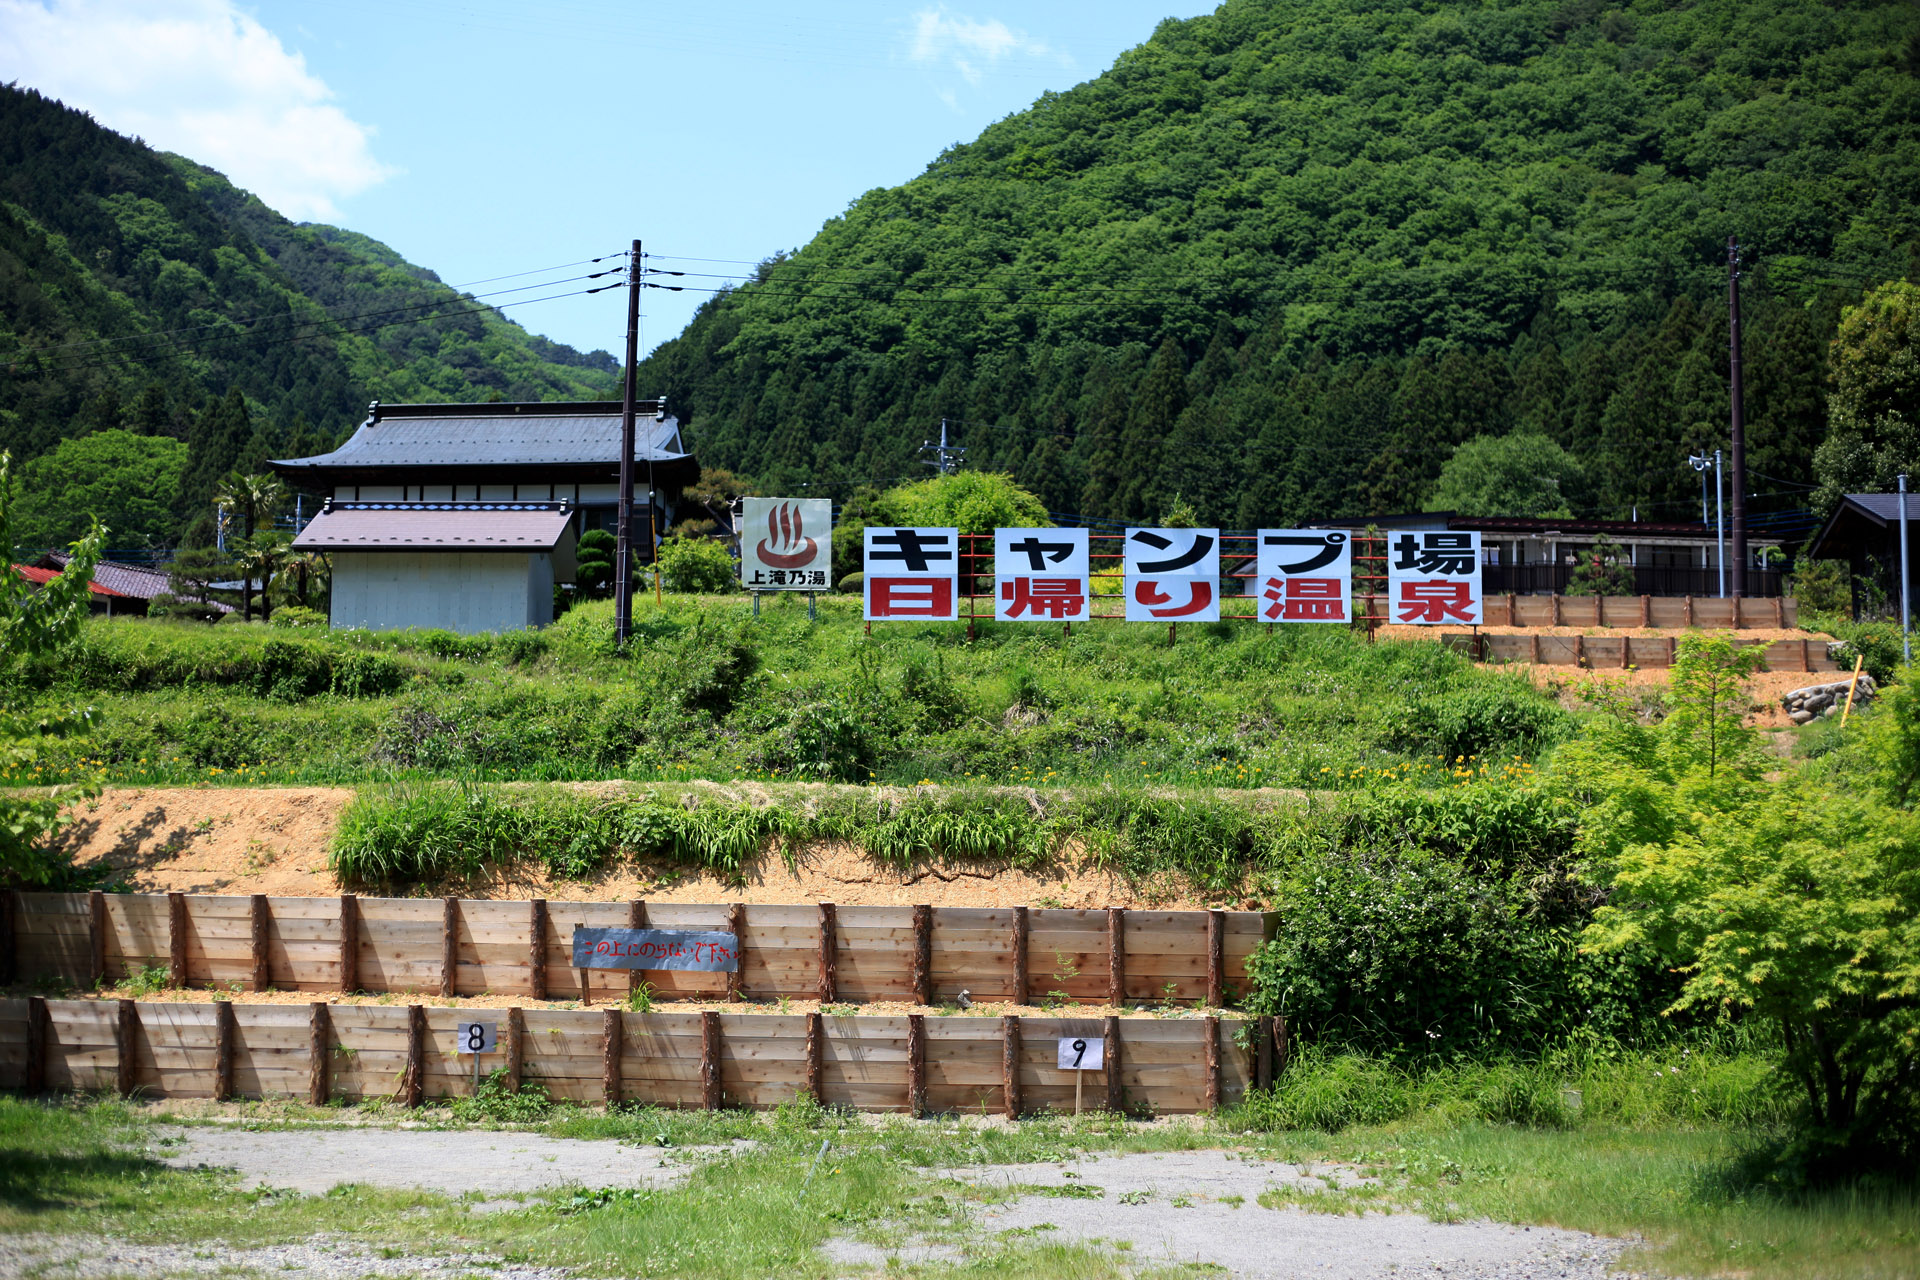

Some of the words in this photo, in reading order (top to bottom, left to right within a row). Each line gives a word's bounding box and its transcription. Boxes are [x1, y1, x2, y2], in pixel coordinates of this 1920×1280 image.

[869, 530, 1475, 576] キャンプ場
[748, 570, 825, 585] 上滝乃湯
[870, 577, 1476, 622] 日帰り温泉
[585, 941, 738, 963] この上にのらないで下さい
[468, 1024, 485, 1051] 8
[1072, 1039, 1087, 1067] 9
